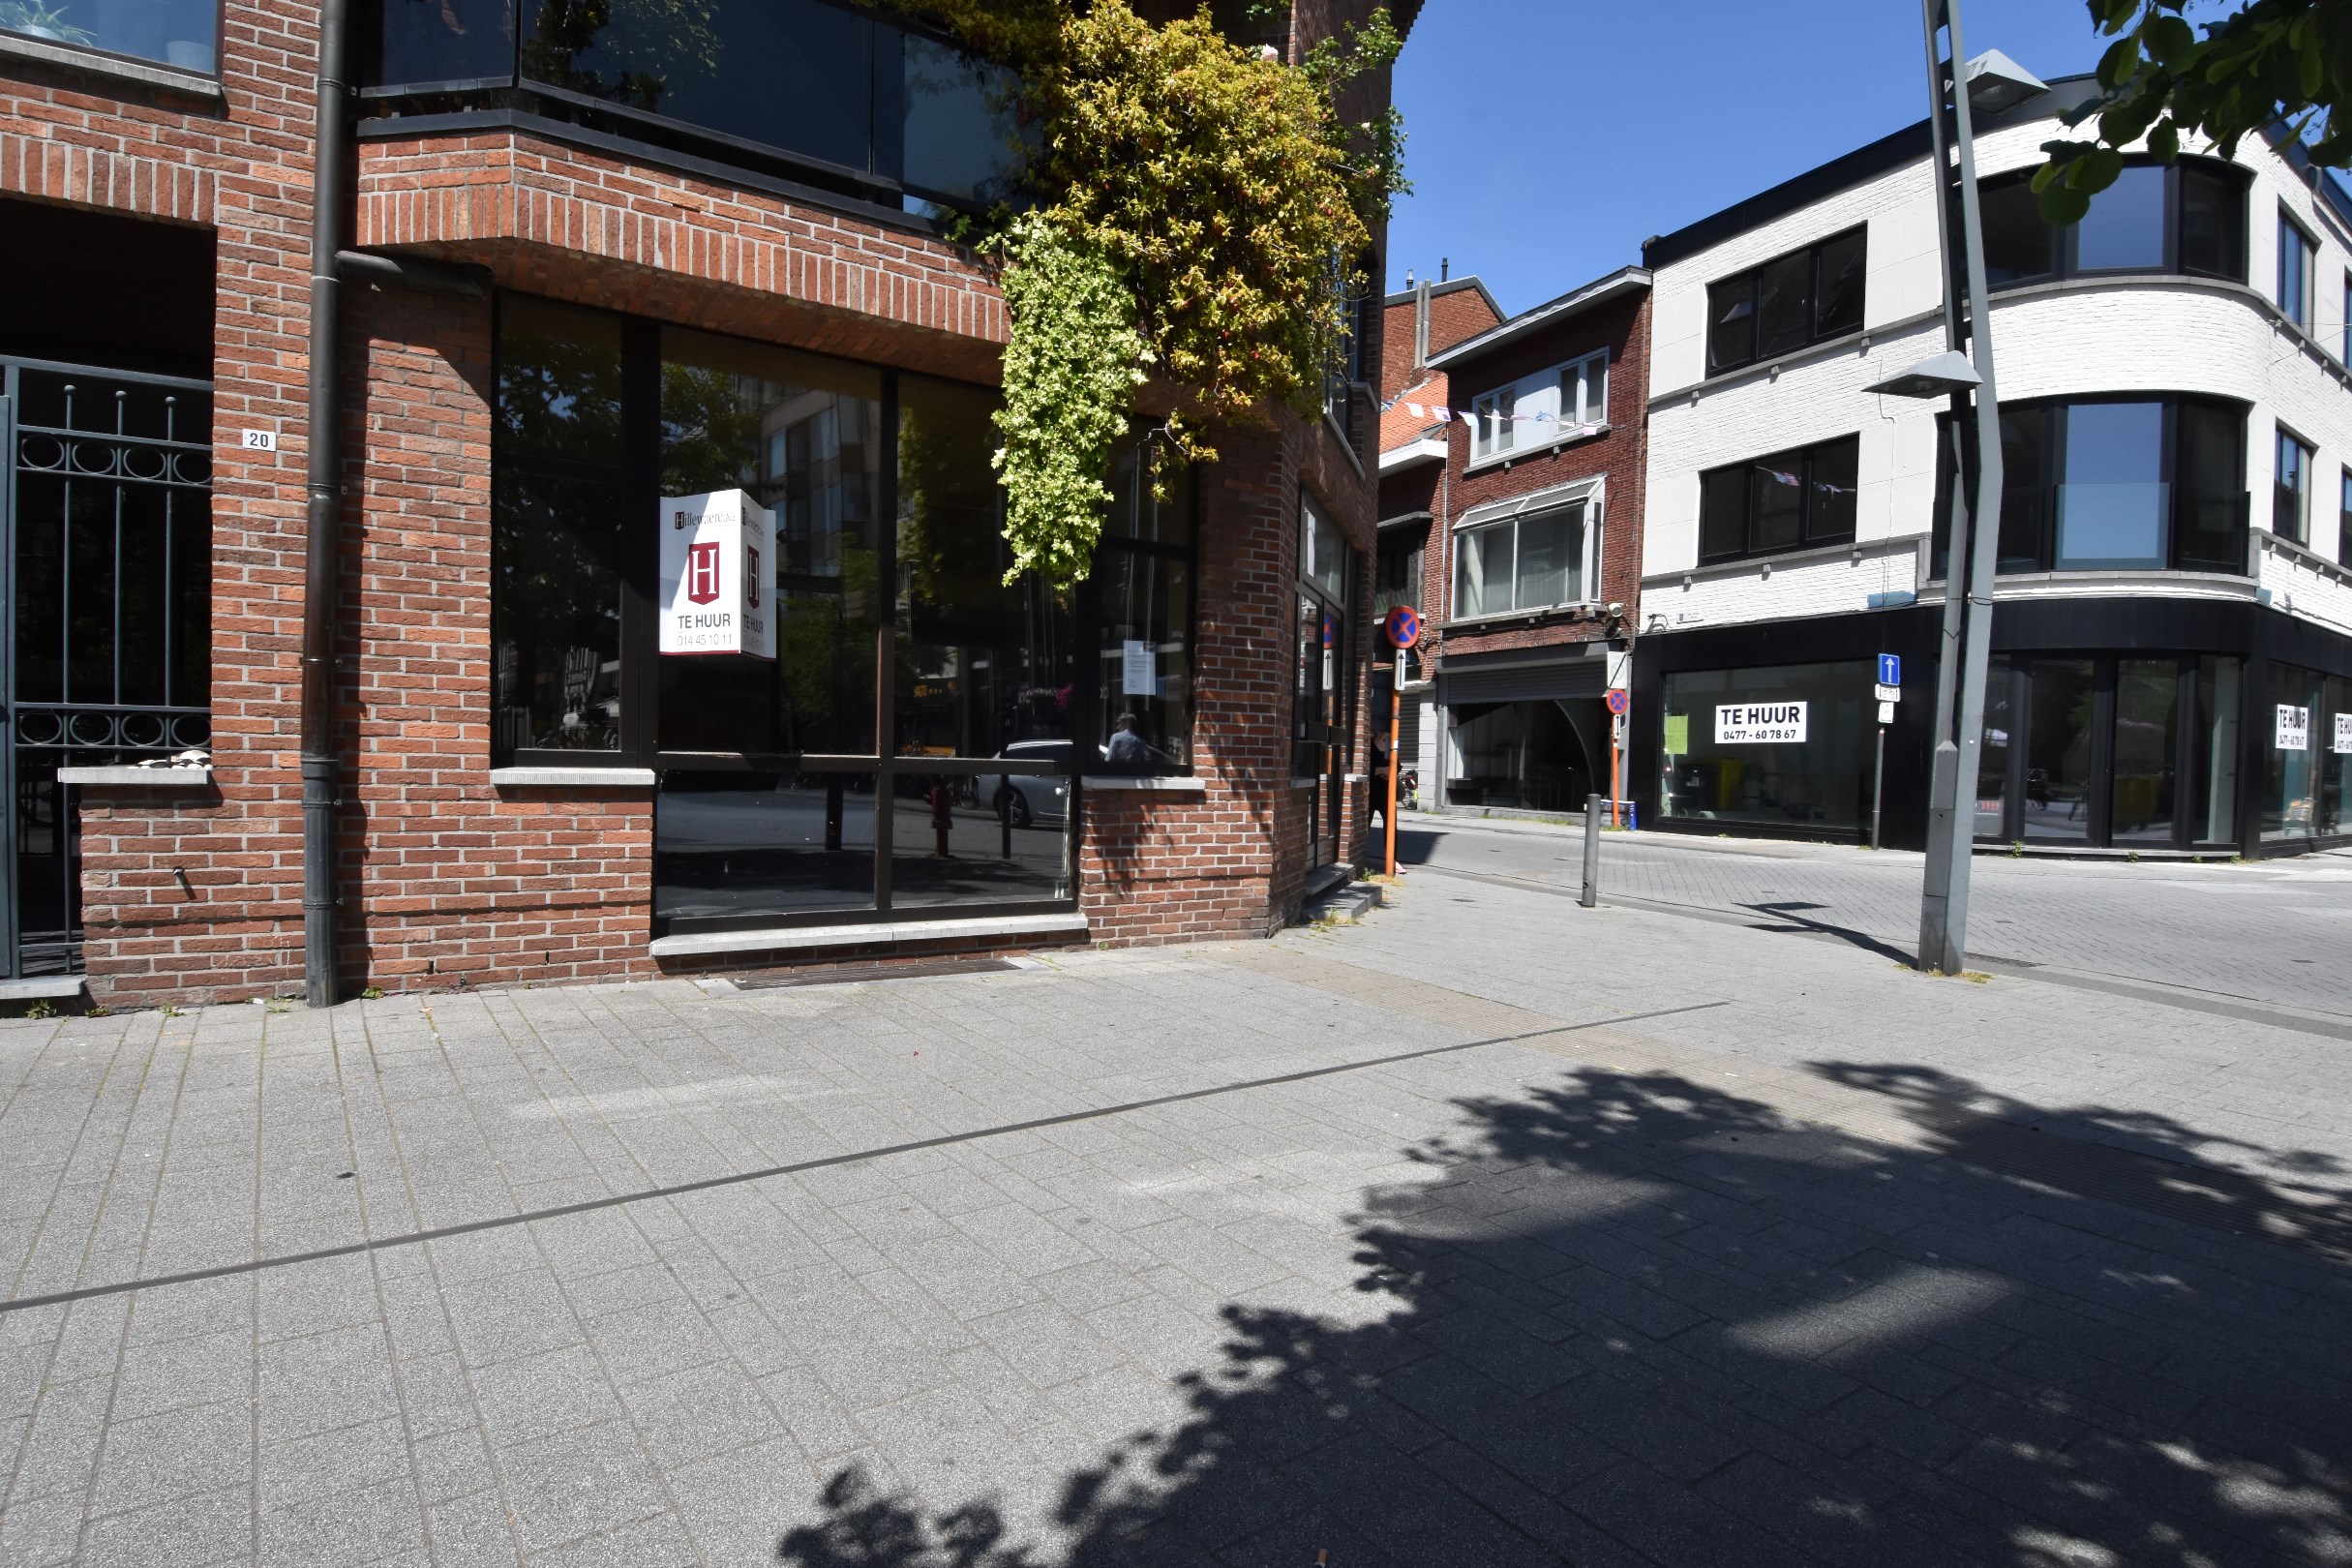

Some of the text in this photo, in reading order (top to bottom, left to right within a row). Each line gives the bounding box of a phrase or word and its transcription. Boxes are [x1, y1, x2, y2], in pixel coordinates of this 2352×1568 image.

[250, 433, 269, 447] 20
[691, 548, 717, 596] H
[678, 613, 731, 629] TE HUUR
[742, 614, 764, 635] TE HUUR
[677, 633, 732, 647] 014 45 10 11
[1721, 707, 1799, 725] TE HUUR
[2279, 709, 2306, 729] TE HUUR
[1723, 731, 1747, 740] 0477
[1755, 730, 1767, 739] 60
[1769, 730, 1782, 739] 78
[1784, 729, 1796, 739] 67
[2337, 717, 2344, 735] TE
